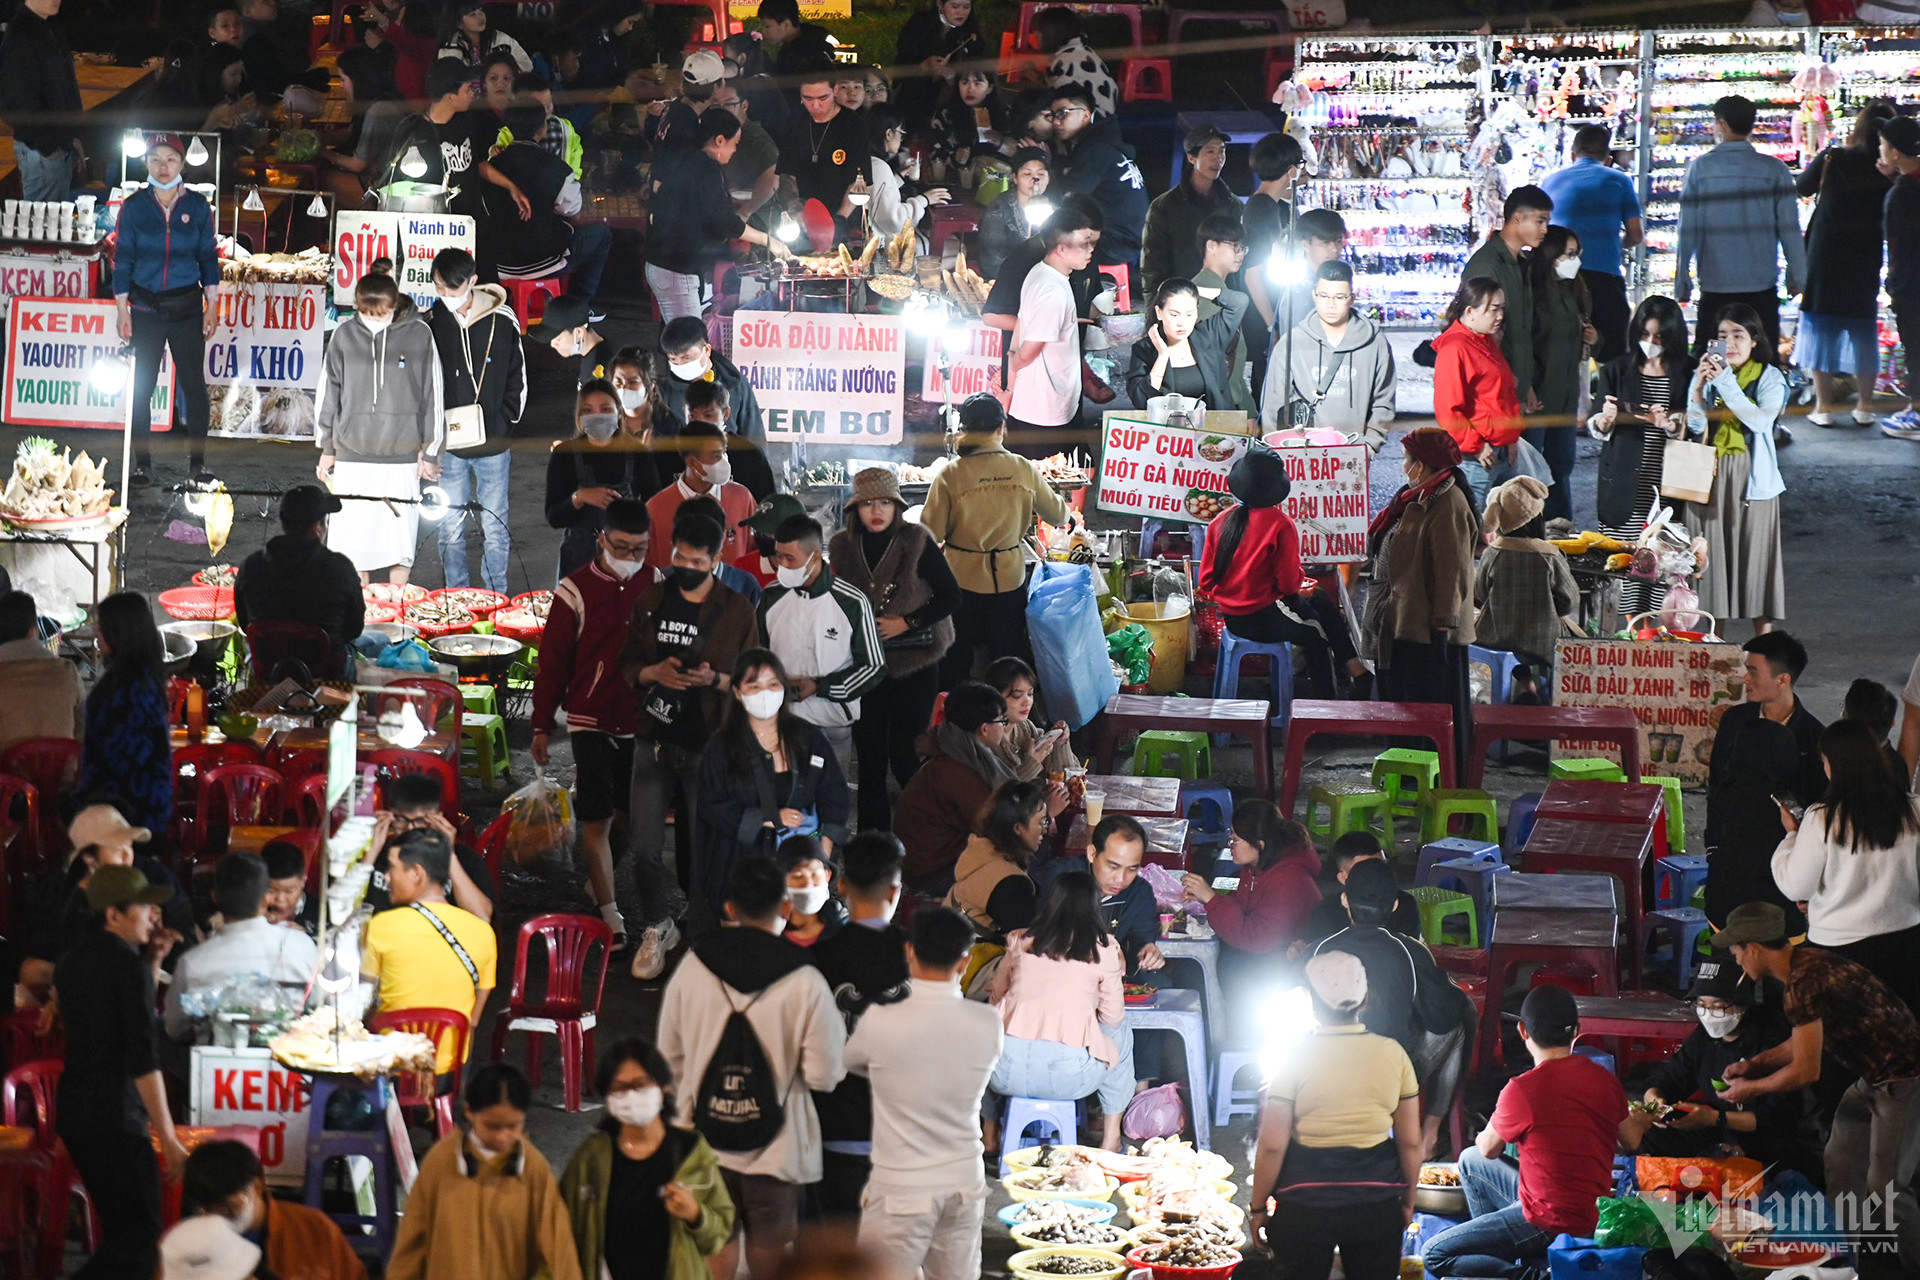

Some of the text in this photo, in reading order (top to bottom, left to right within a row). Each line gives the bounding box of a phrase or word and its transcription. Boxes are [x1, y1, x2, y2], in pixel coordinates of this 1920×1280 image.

[449, 222, 466, 236] bò
[2, 267, 45, 297] KEM
[21, 312, 105, 335] KEM
[263, 289, 315, 331] KHÔ
[740, 319, 782, 348] SỮA
[788, 321, 831, 355] ĐẬU
[838, 322, 898, 352] NÀNH
[22, 342, 87, 369] YAOURT
[209, 336, 239, 378] CÁ
[249, 339, 304, 381] KHÔ
[16, 378, 81, 405] YAOURT
[739, 361, 896, 394] BÁNH TRÁNG NƯỚNG
[931, 361, 984, 394] NỚNG
[760, 408, 892, 436] EM BƠ
[1109, 426, 1194, 459] SÚP CUA
[1104, 457, 1139, 482] HỘT
[1143, 462, 1167, 484] GÀ
[1285, 449, 1341, 481] ỮA BẮP
[1100, 488, 1182, 513] MUỐI TIÊU
[1288, 490, 1365, 524] ĐẬU NÀNH
[1300, 529, 1366, 562] ẬU XANH
[657, 632, 679, 644] GETS
[660, 620, 667, 631] A
[668, 621, 688, 632] BOY
[1562, 643, 1592, 666] SỮA
[1597, 644, 1627, 670] ĐẬU
[1632, 646, 1674, 668] NÀNH
[1561, 672, 1592, 693] SỮA
[1597, 673, 1627, 698] ĐẬU
[1632, 678, 1674, 697] XANH
[214, 1068, 303, 1113] KEM
[260, 1121, 287, 1168] Ơ
